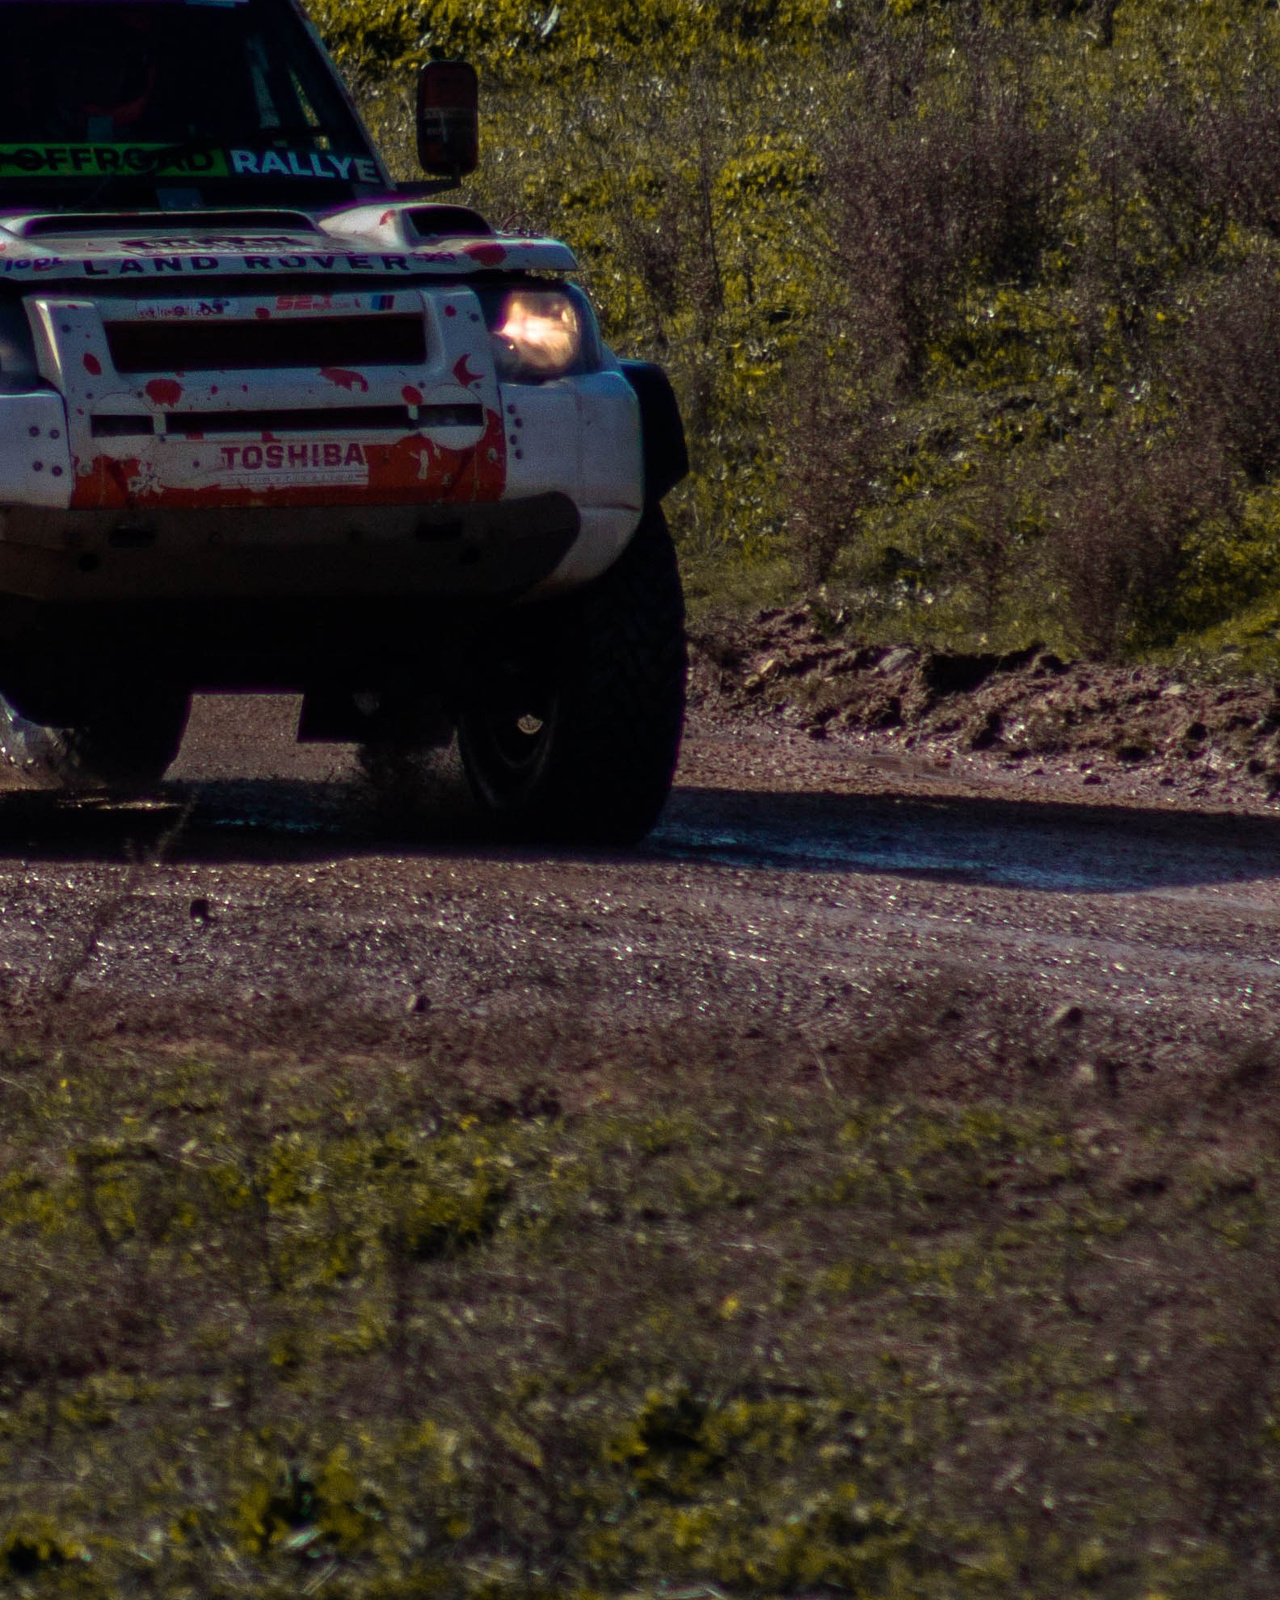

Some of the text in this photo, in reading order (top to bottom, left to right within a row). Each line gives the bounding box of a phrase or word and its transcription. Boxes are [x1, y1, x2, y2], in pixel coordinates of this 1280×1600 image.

[230, 149, 382, 183] RALLYE
[83, 255, 219, 276] LAND
[243, 254, 412, 272] ROVER
[219, 442, 365, 470] TOSHIBA
